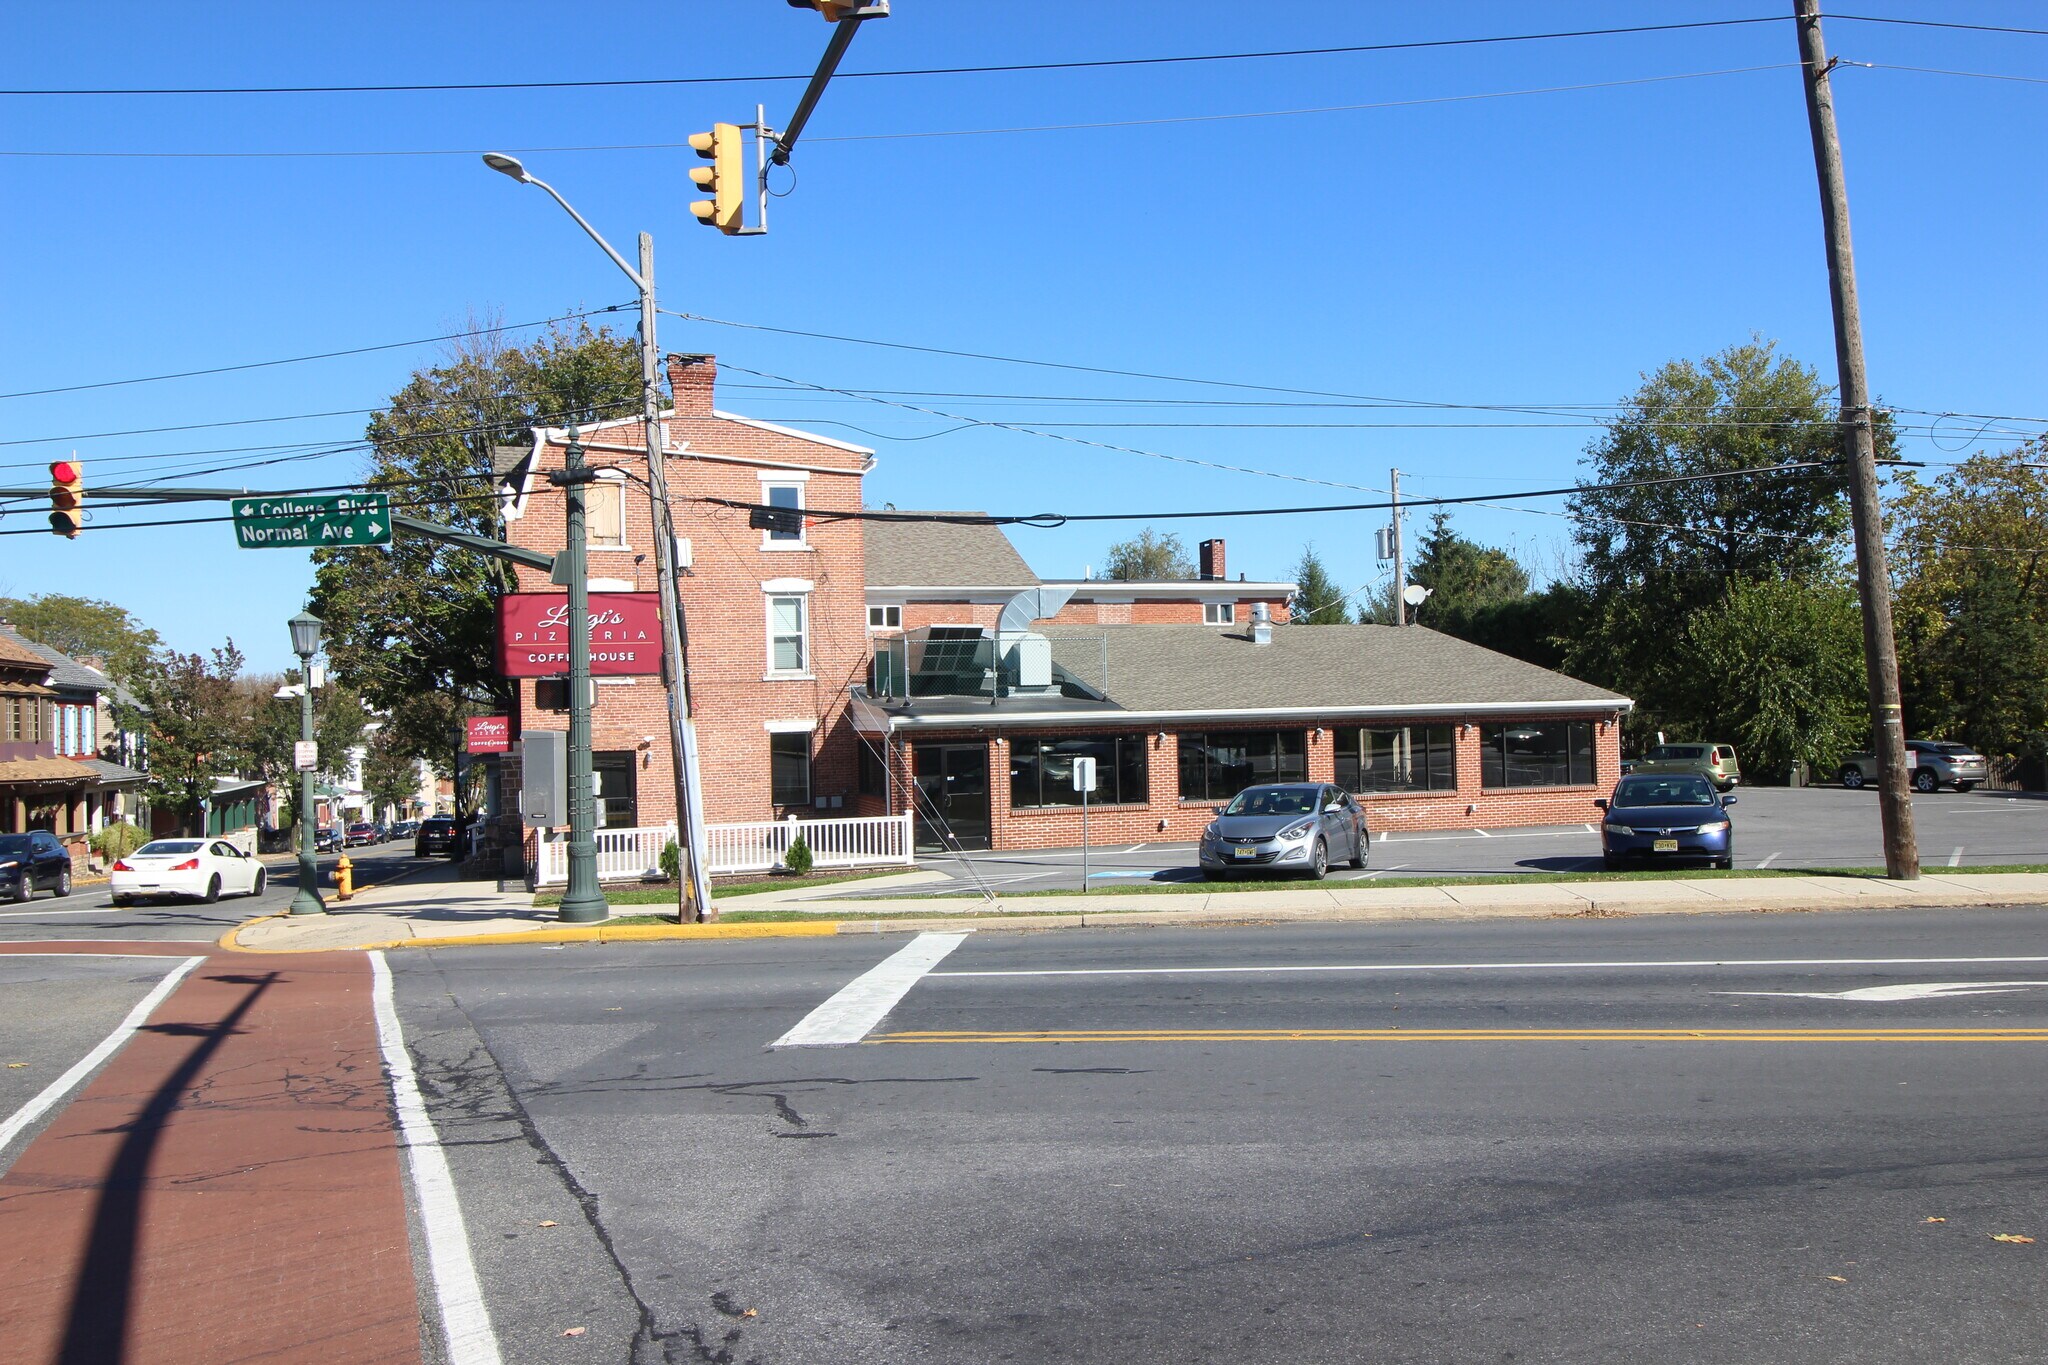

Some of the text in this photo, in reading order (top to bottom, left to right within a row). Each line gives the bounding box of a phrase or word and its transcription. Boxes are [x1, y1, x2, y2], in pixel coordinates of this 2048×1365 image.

[260, 498, 378, 522] College Blvd
[241, 522, 354, 542] Normal Ave
[538, 603, 624, 630] Lgi's
[515, 630, 647, 641] PIZERIA
[528, 652, 635, 663] COFF HOUSE
[474, 721, 506, 732] Luigi's
